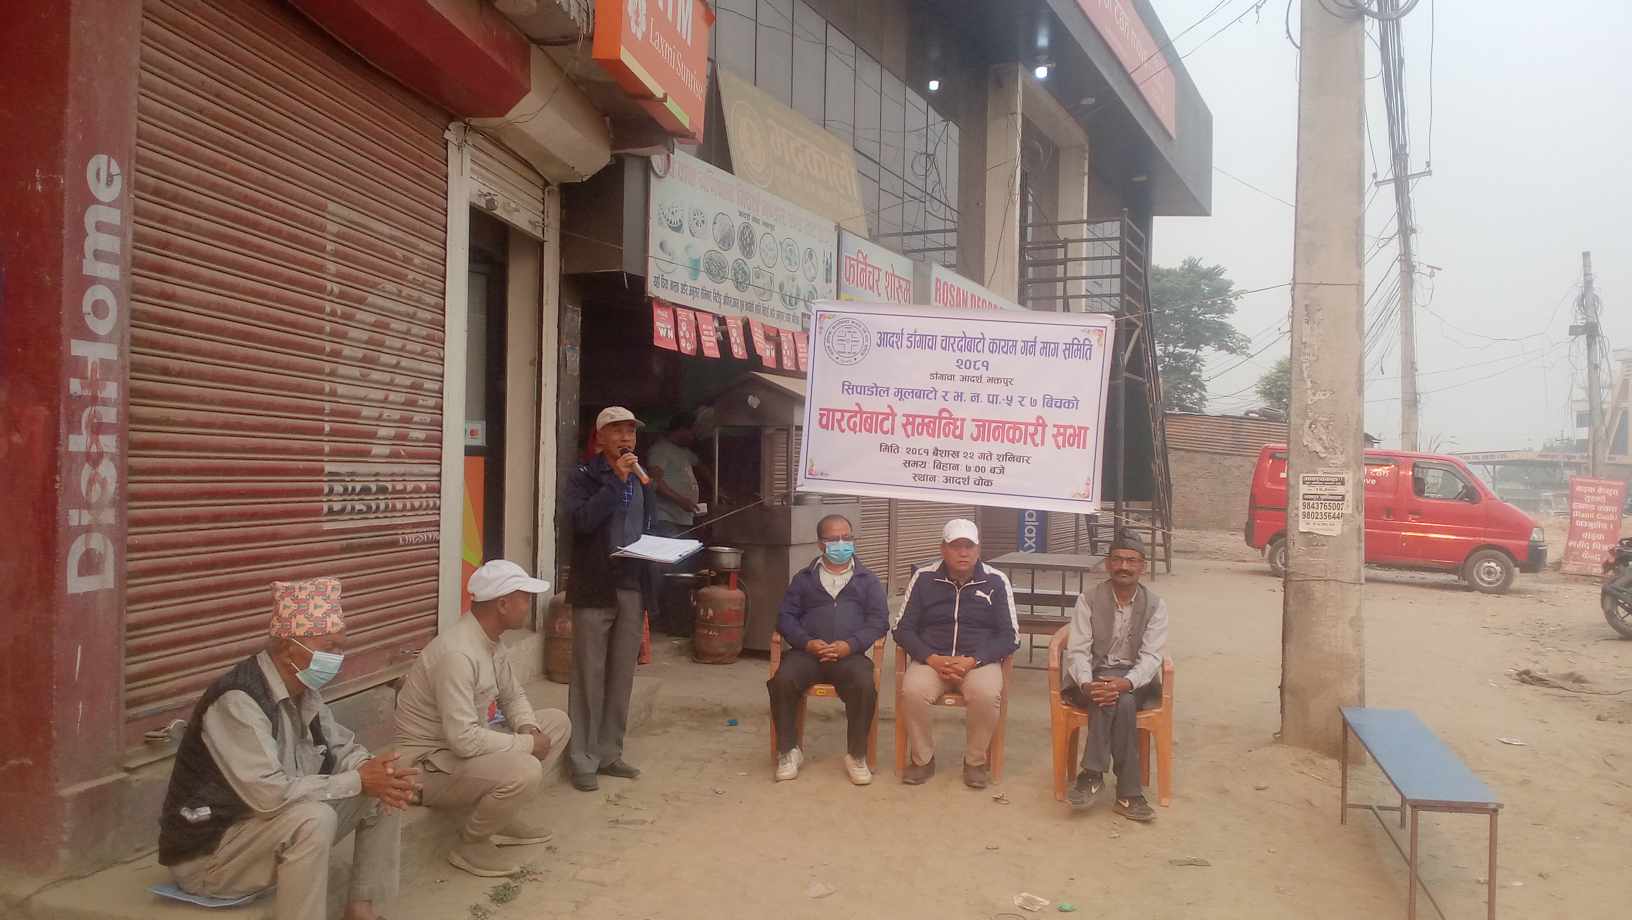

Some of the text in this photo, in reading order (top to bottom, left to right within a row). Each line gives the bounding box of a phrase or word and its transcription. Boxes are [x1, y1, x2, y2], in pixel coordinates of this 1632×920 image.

[649, 17, 676, 70] Laxmi
[876, 328, 904, 350] आदर्श
[940, 330, 986, 354] चारदोबाटो
[988, 336, 1018, 357] कायम
[1020, 336, 1038, 357] गर्न
[1039, 340, 1060, 360] माग
[1062, 337, 1094, 361] समिति
[66, 153, 122, 595] DishHome
[955, 358, 990, 371] २०८१
[959, 374, 983, 384] आदर्श
[841, 380, 890, 398] सिपाडोल
[942, 391, 950, 401] र
[1017, 395, 1028, 407] र
[1030, 397, 1038, 407] ७
[818, 403, 1090, 450] चारदोबाटो सम्बन्धि जानकारी सभा
[902, 459, 927, 469] समय
[905, 447, 929, 458] २०८१
[963, 451, 975, 460] २२
[976, 451, 993, 461] गते
[912, 472, 937, 483] स्थान
[942, 474, 970, 486] आदर्श
[1019, 510, 1039, 553] alaxy
